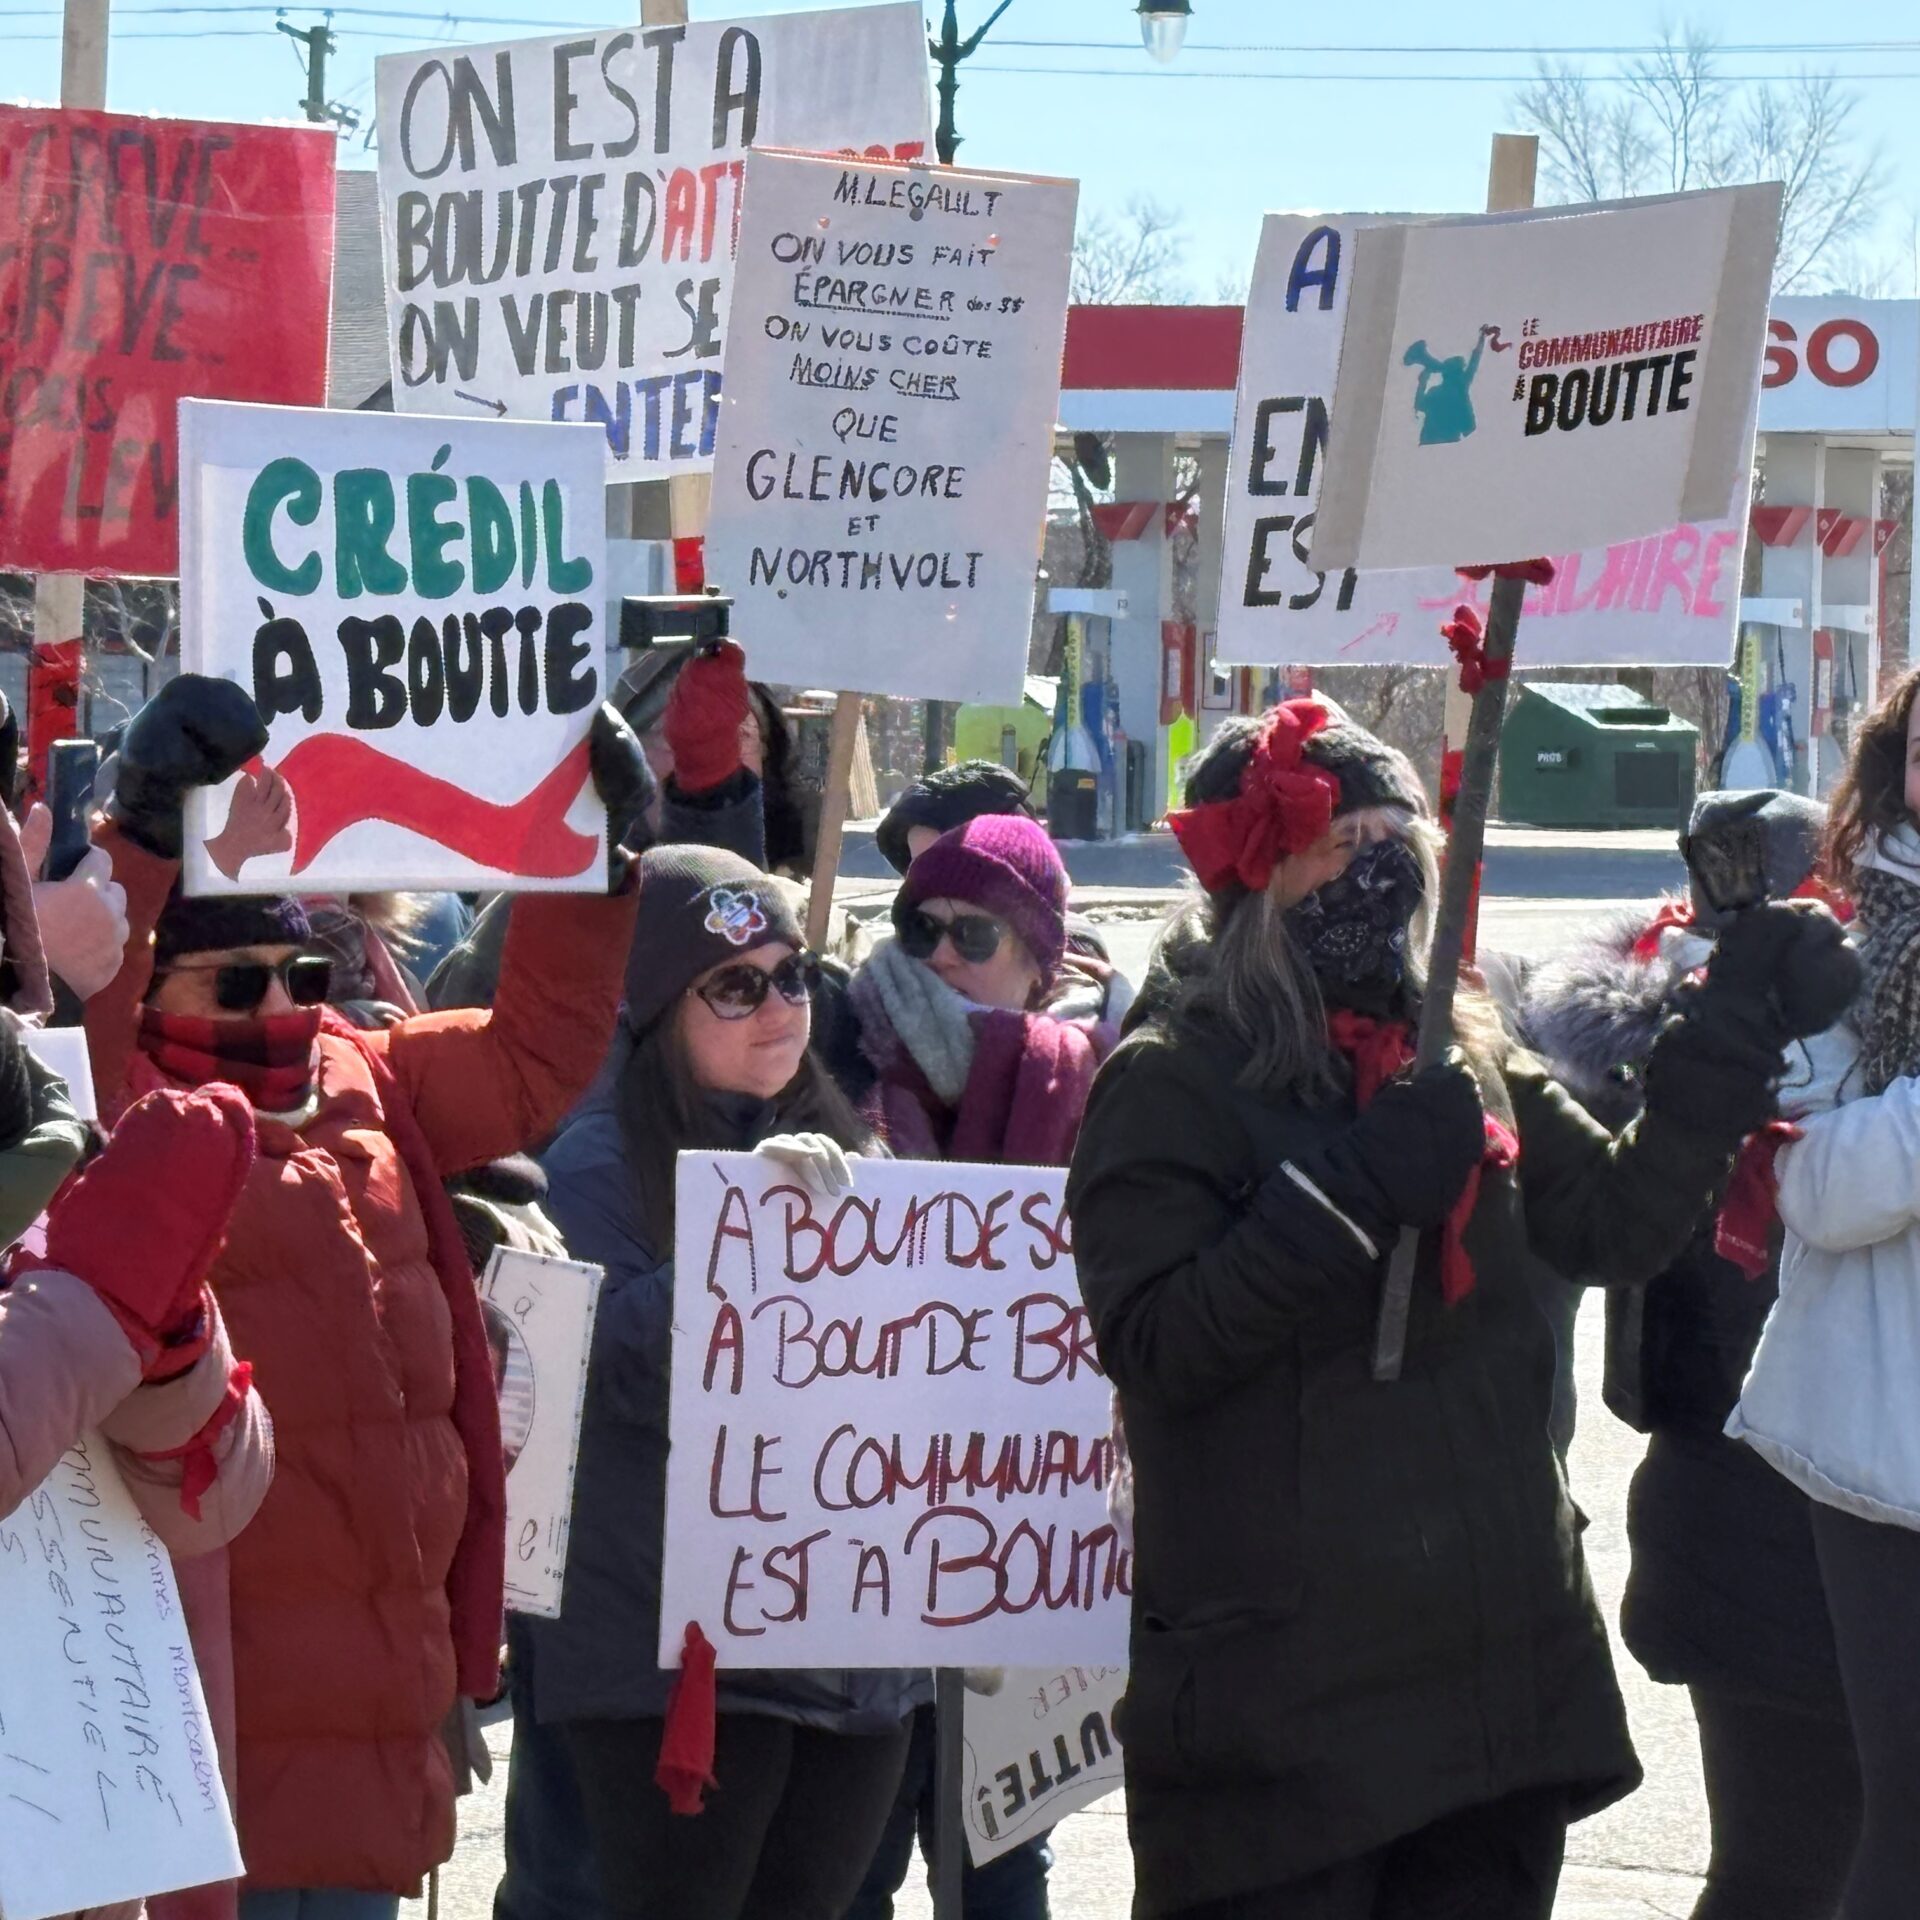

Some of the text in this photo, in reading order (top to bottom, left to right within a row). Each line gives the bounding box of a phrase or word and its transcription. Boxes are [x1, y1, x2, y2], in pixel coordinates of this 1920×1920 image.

[400, 25, 762, 179] ON EST A
[397, 173, 606, 292] BOUTTE
[771, 232, 826, 262] ON
[838, 241, 914, 266] VOUS
[1285, 226, 1341, 313] A
[795, 265, 955, 312] ÉPARGNER
[400, 277, 721, 387] ON VEUT SE
[764, 314, 993, 359] ON VOUS COÛTE
[1518, 314, 1705, 370] COMMUNAUTAIRE
[889, 368, 960, 397] CHER
[1525, 349, 1697, 437] BOUTTE
[832, 407, 899, 444] QUE
[746, 448, 967, 502] GLENCORE
[243, 443, 593, 600] CRÉDIL
[847, 514, 882, 537] ET
[750, 546, 984, 591] NORTHVOLT
[253, 595, 597, 730] À BOUTTE
[944, 1190, 1015, 1270] DE
[916, 1301, 993, 1376] DE
[710, 1424, 788, 1522] LE
[724, 1529, 832, 1637] EST
